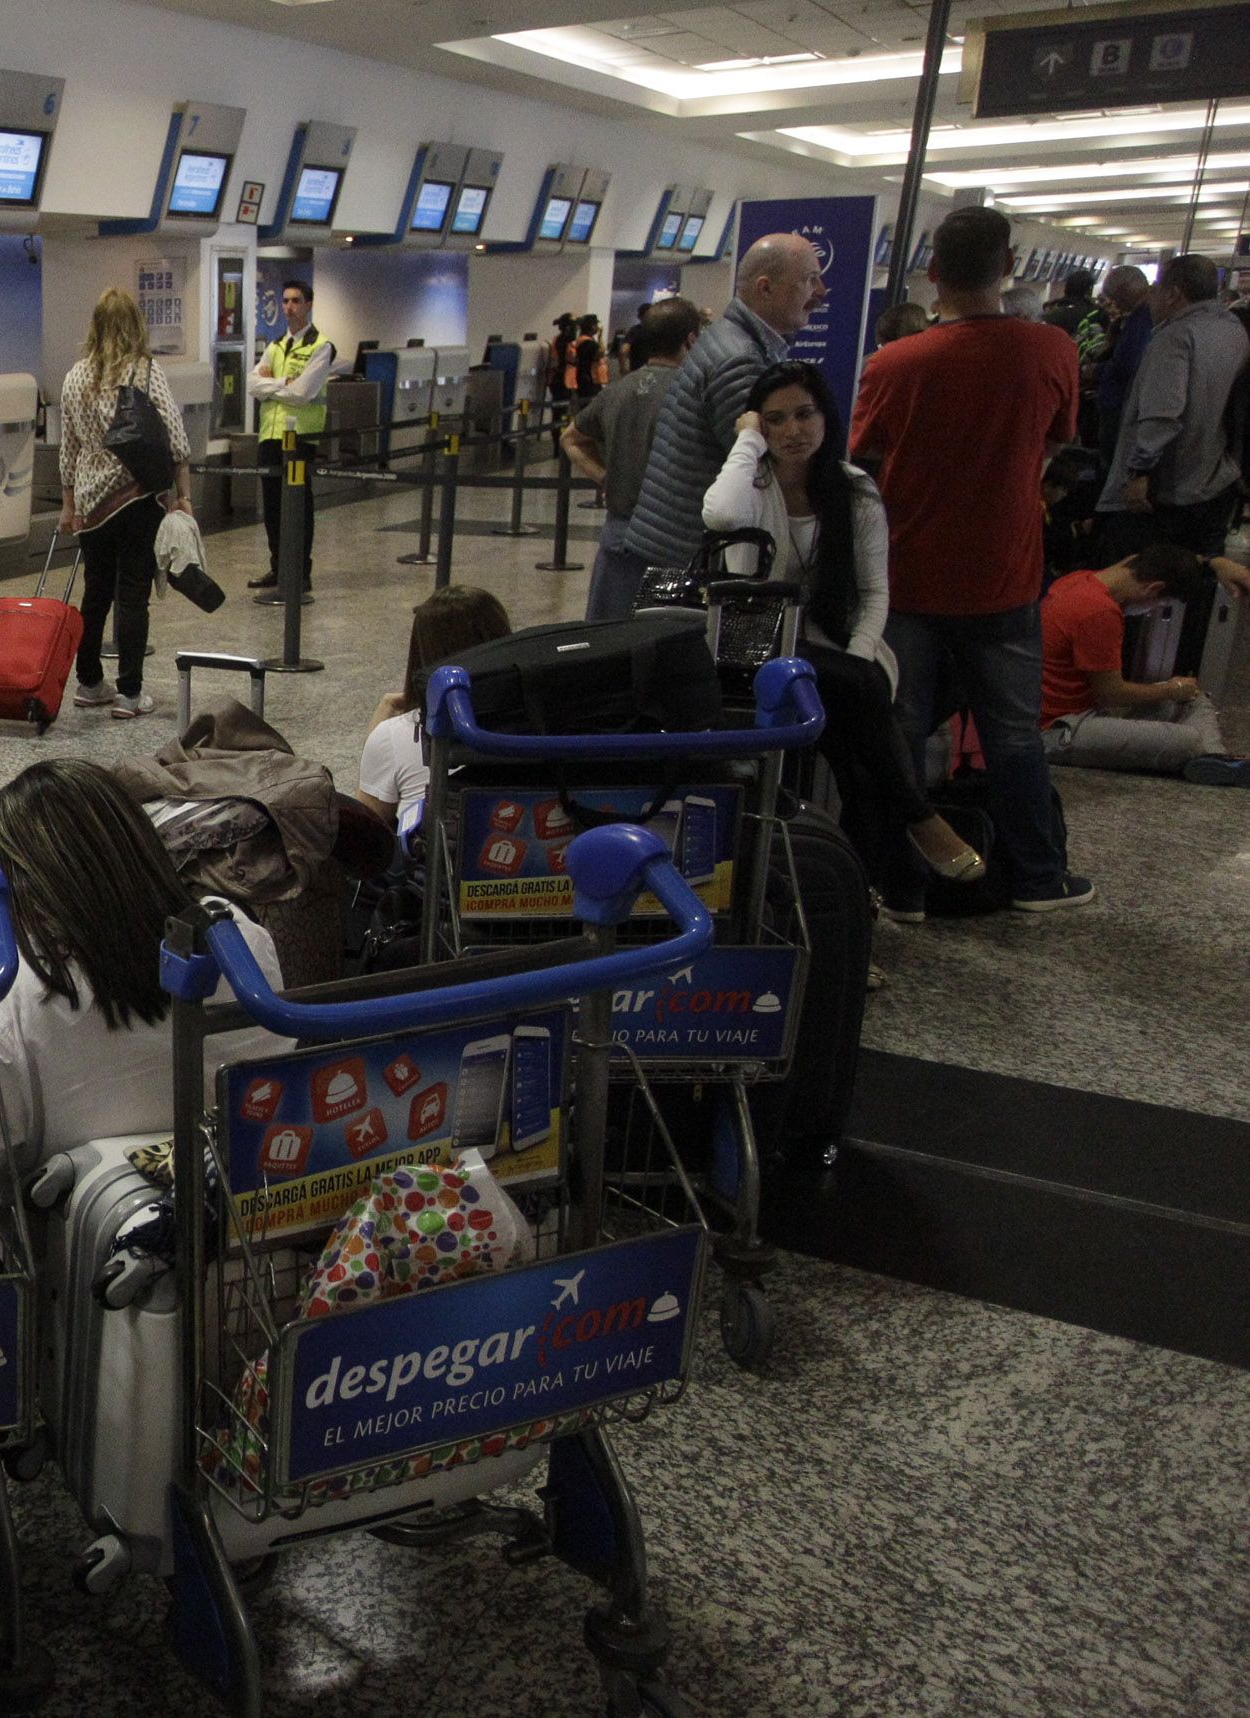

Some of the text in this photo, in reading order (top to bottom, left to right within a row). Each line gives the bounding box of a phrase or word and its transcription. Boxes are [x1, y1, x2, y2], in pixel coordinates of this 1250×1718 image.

[43, 93, 56, 116] 6
[187, 115, 200, 137] 7
[521, 880, 555, 895] GRATIS
[557, 879, 570, 892] LA
[519, 894, 558, 908] MUCHO
[635, 1029, 679, 1043] PARA
[687, 1029, 709, 1043] TU
[716, 1029, 760, 1046] VIAJE
[310, 1172, 354, 1198] GRATIS
[357, 1168, 372, 1185] LA
[418, 1147, 441, 1164] APP
[305, 1323, 536, 1410] despegar
[323, 1344, 655, 1447] EL MEJOR PRECIO PARA TU VIAJE
